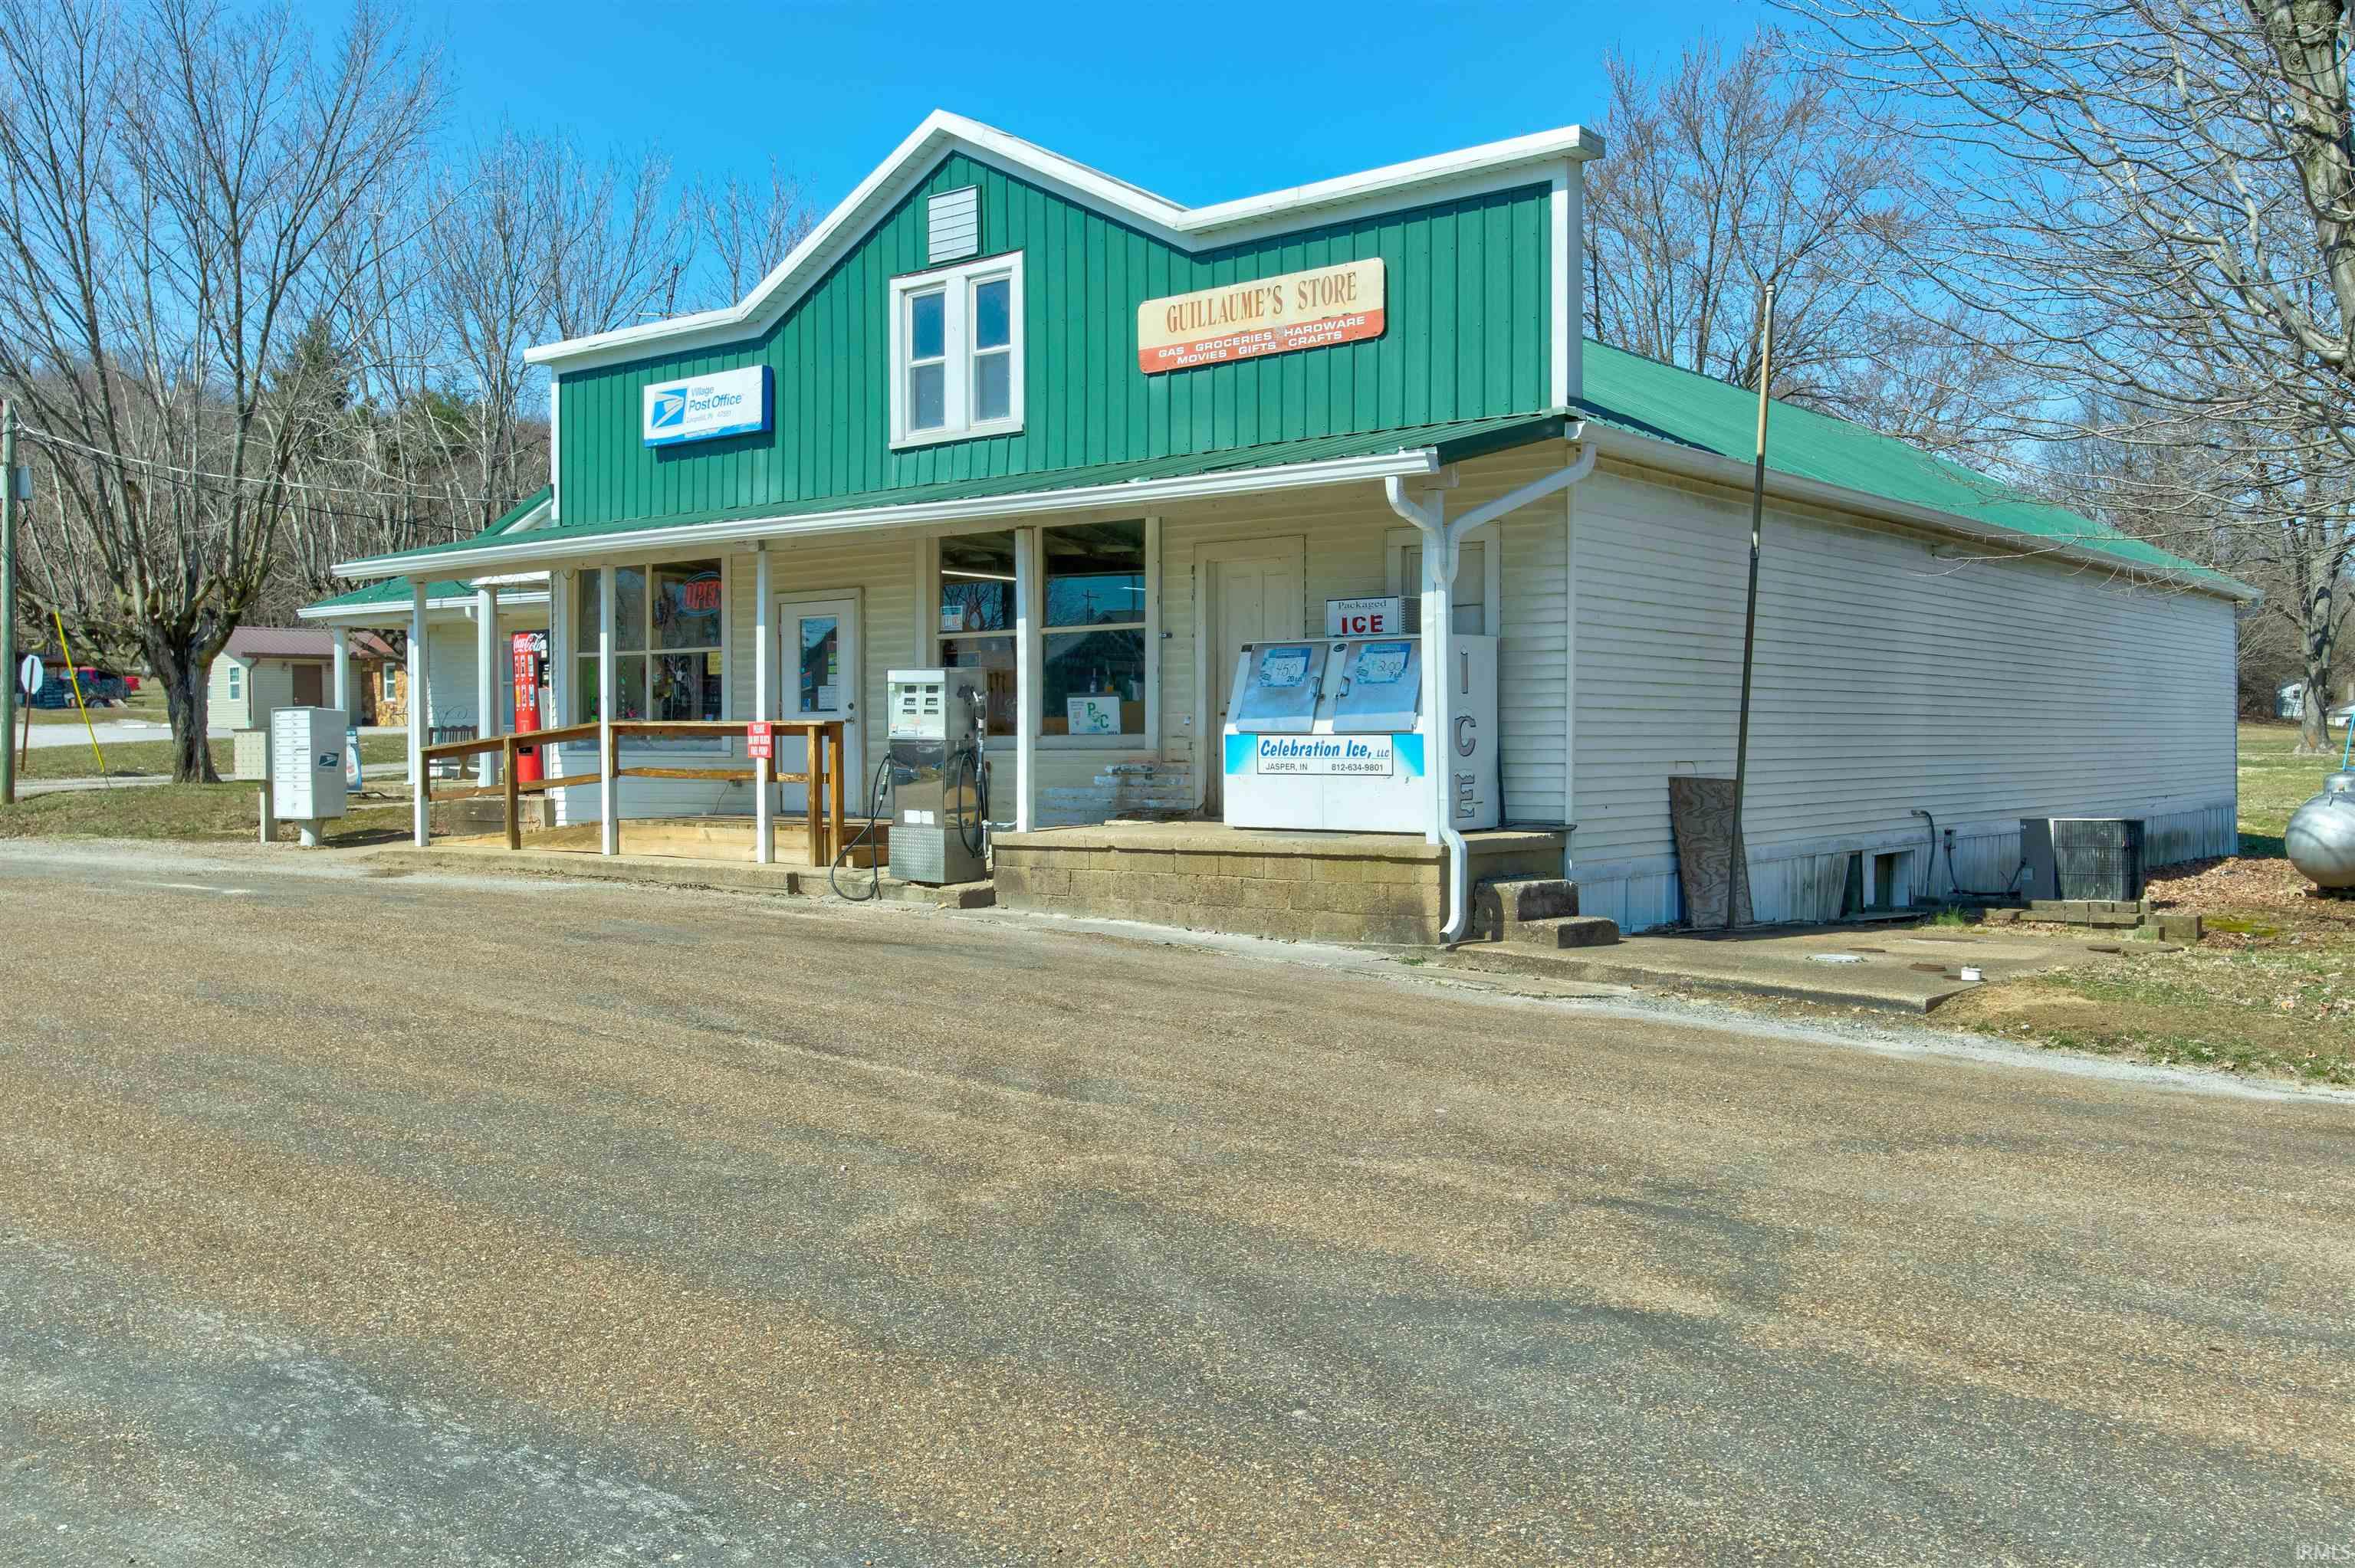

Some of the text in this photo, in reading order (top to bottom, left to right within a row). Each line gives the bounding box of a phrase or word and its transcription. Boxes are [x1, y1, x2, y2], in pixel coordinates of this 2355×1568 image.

[1166, 271, 1357, 333] GUILLAUME'S STORE
[1158, 316, 1365, 359] GAS GROCERIES HARDWARE
[1176, 330, 1342, 366] MOVIES GIFTS CRAFTS
[688, 393, 742, 412] Post Office
[1338, 600, 1387, 611] Packaged
[1342, 615, 1384, 635] ICE
[1260, 739, 1390, 759] Celebration Ice, LLC
[1266, 763, 1298, 772] JASPER,
[1331, 763, 1384, 772] 812-634-9801
